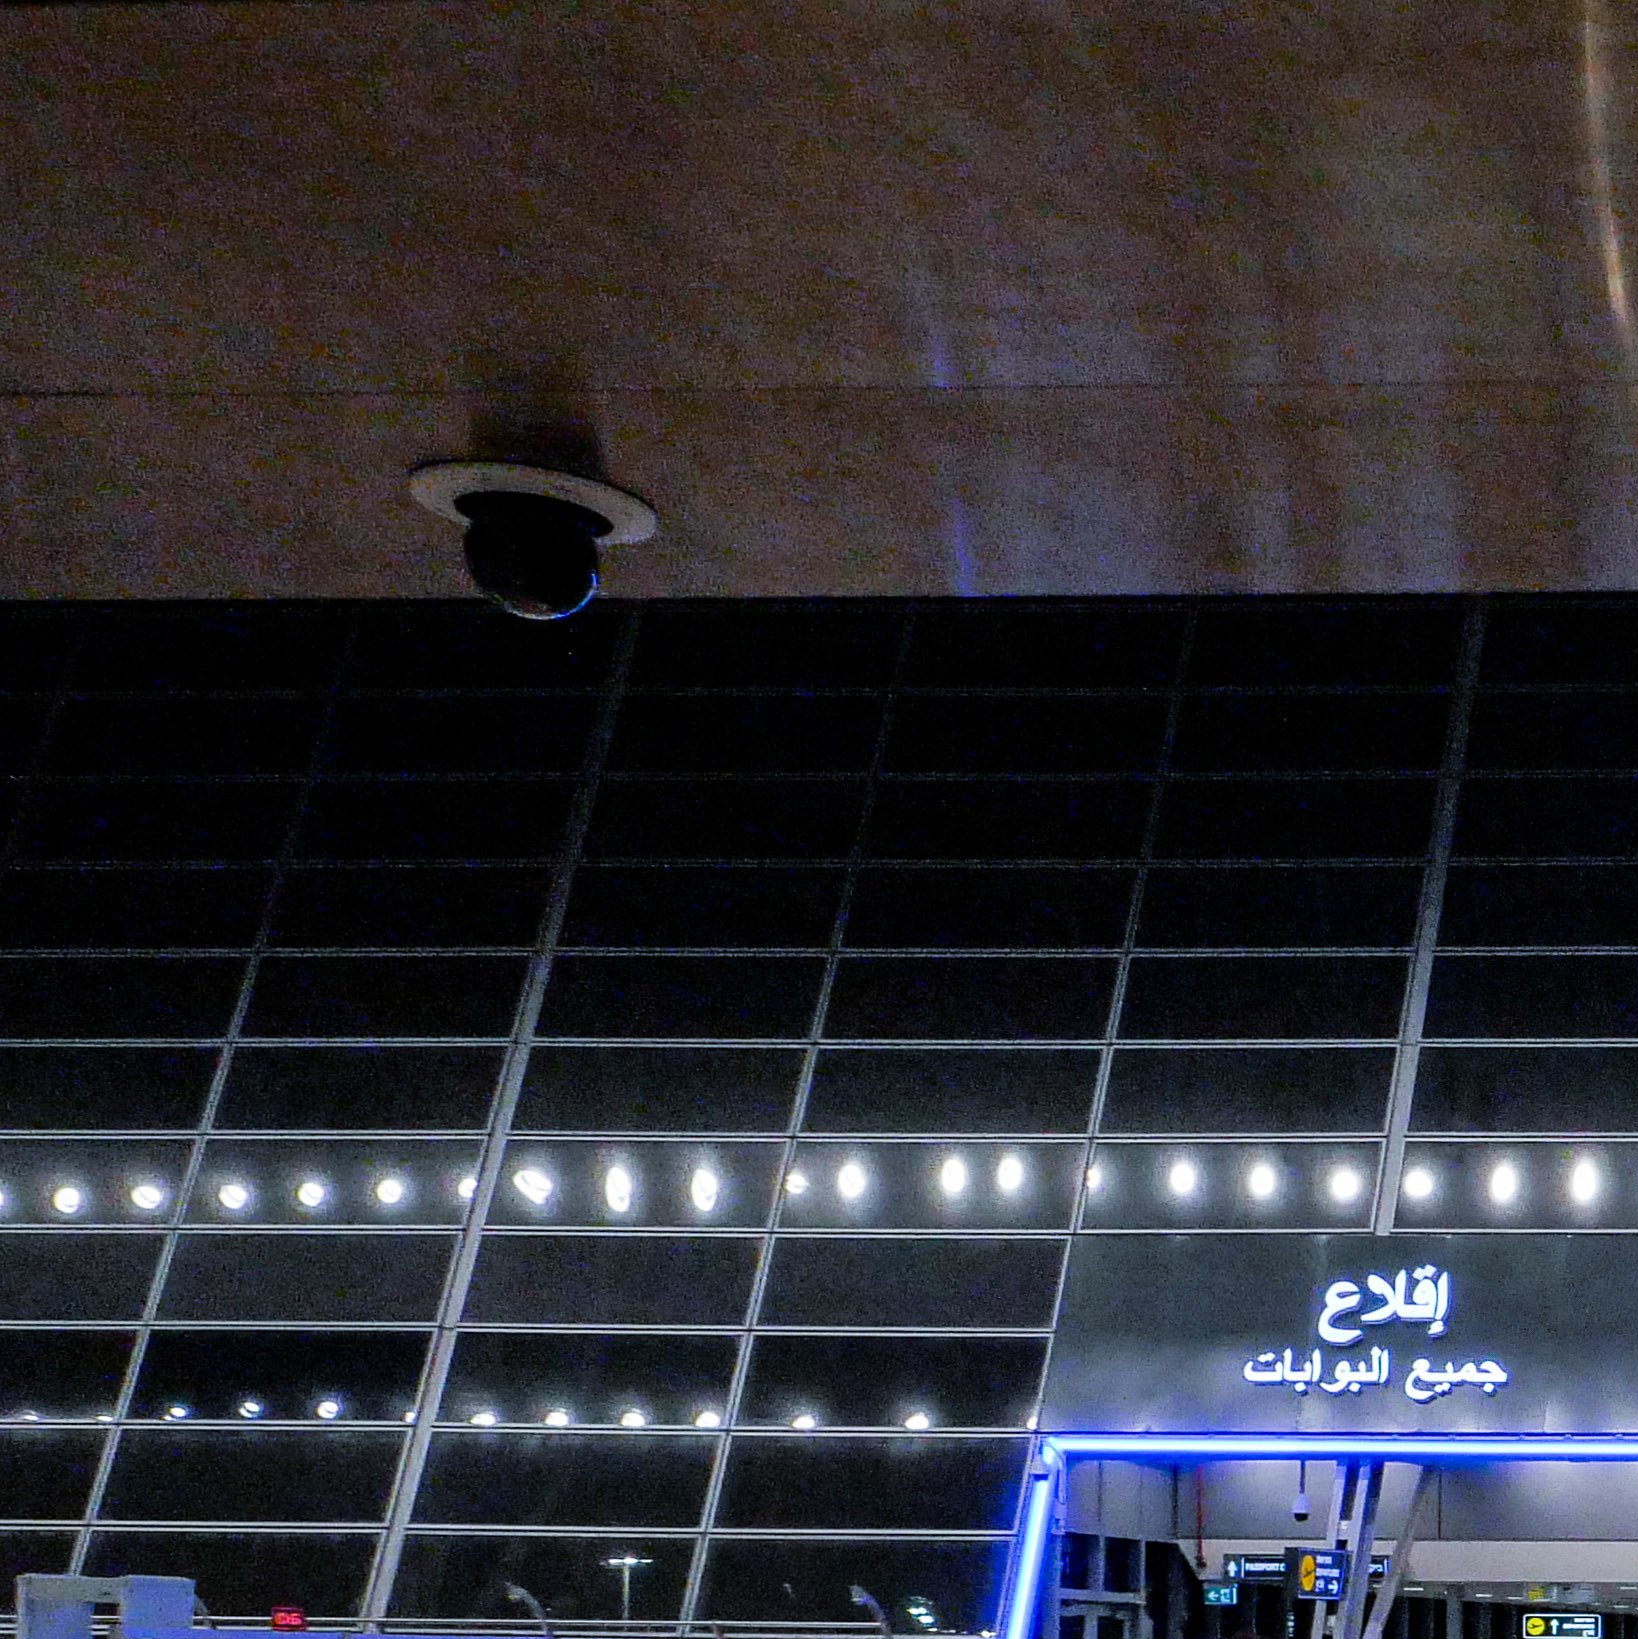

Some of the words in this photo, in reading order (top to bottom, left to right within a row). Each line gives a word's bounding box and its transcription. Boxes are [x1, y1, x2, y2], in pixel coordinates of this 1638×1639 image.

[1317, 1264, 1448, 1344] إقلاع
[1243, 1346, 1389, 1393] البوابات
[1404, 1354, 1508, 1401] جميع
